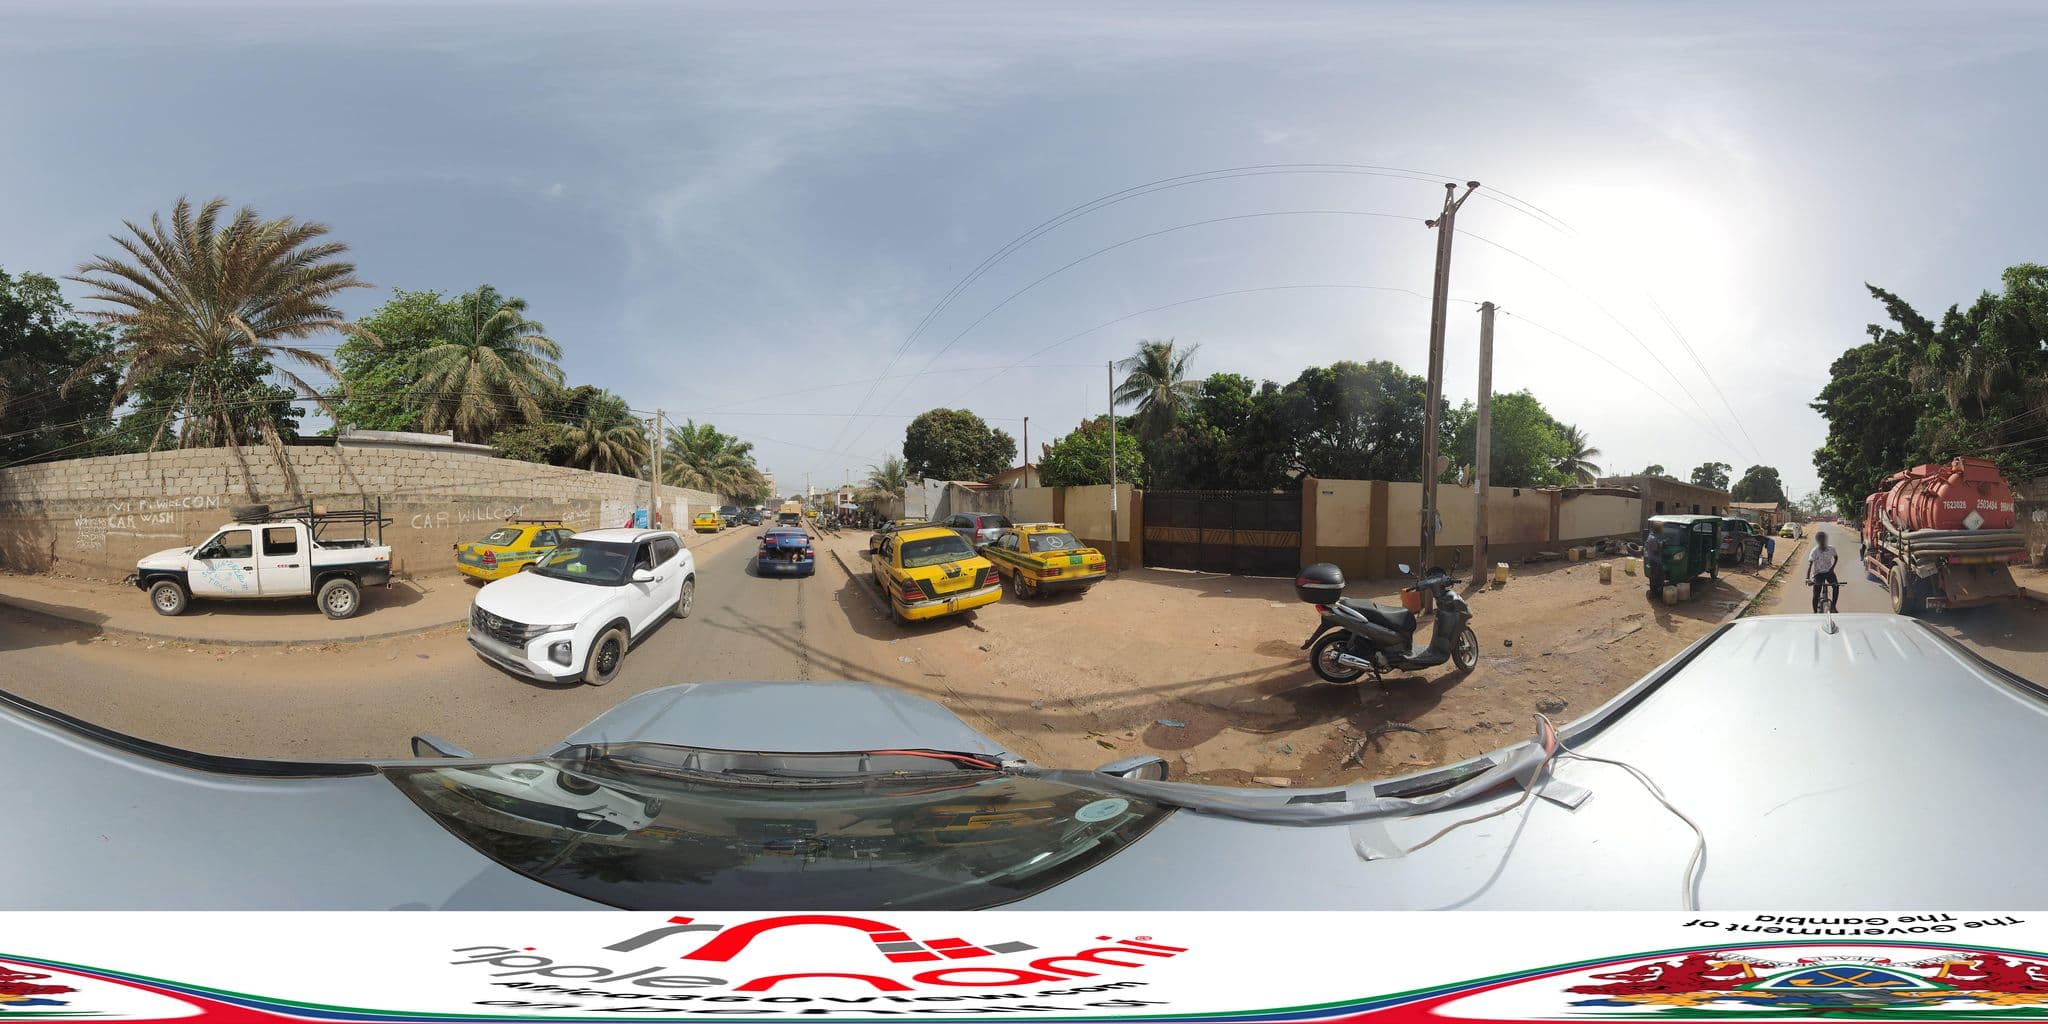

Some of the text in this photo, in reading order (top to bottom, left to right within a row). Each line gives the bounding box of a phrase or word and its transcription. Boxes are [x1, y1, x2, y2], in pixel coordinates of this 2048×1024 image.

[108, 511, 175, 529] CAR WASH
[411, 505, 524, 529] CAR WILLCOM
